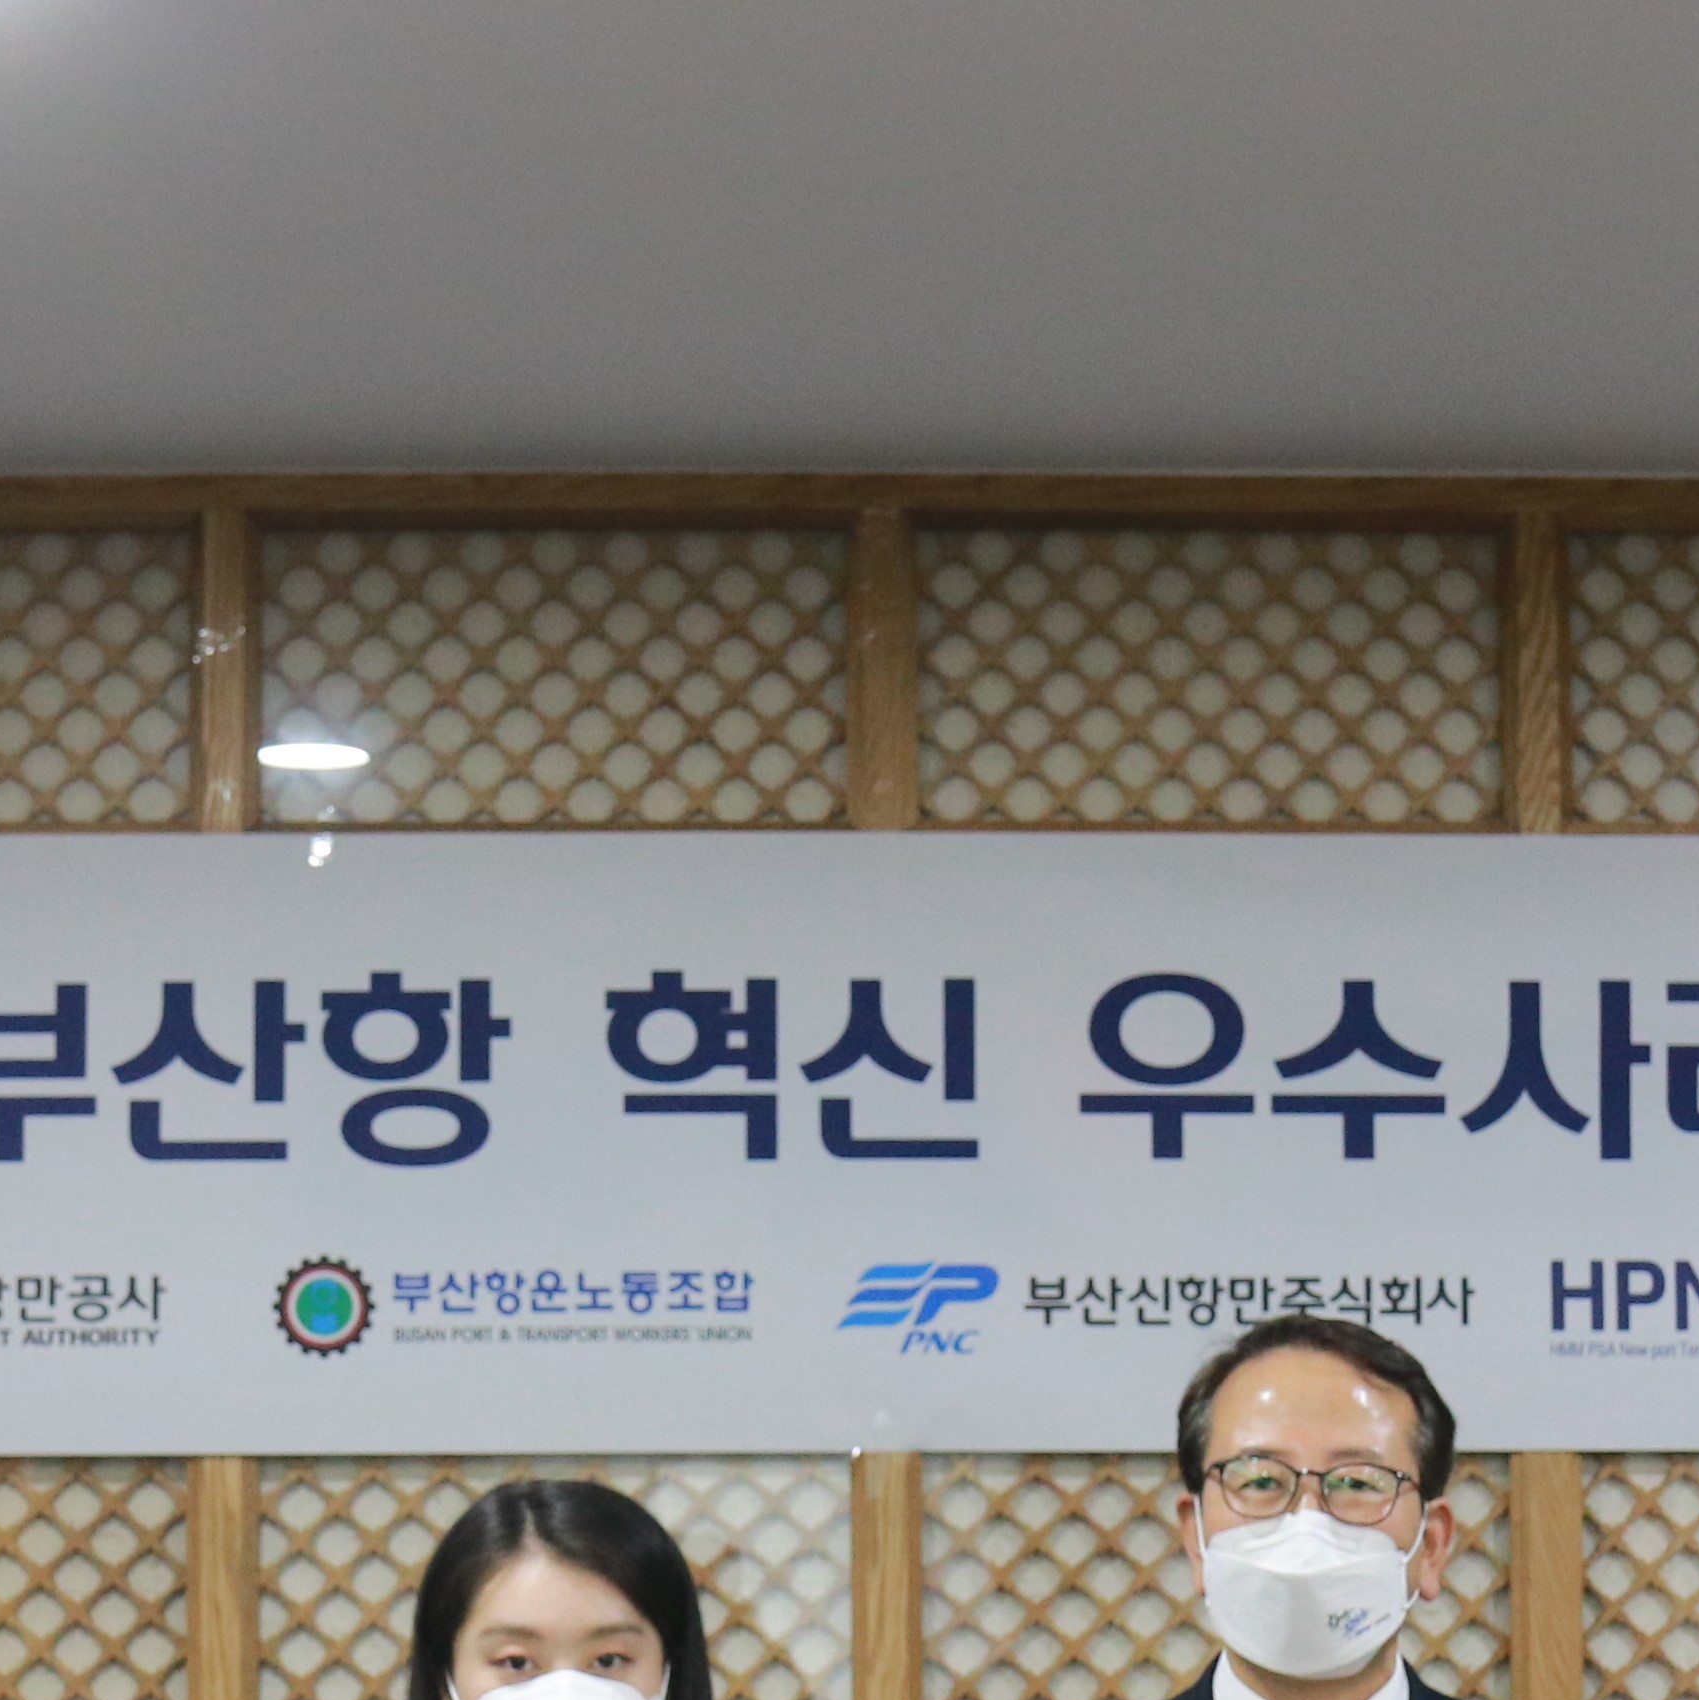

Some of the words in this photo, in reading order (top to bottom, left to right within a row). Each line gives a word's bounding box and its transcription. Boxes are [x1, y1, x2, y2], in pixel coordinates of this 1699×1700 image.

[605, 969, 980, 1162] 혁신
[392, 1269, 754, 1316] 부산항운노동조합
[1024, 1274, 1475, 1327] 부산신항만주식회사
[21, 1330, 160, 1347] AUTHORITY
[394, 1327, 446, 1342] BUSAN
[452, 1327, 492, 1342] PORT
[517, 1327, 608, 1342] TRANSPORT
[901, 1330, 981, 1355] PNC
